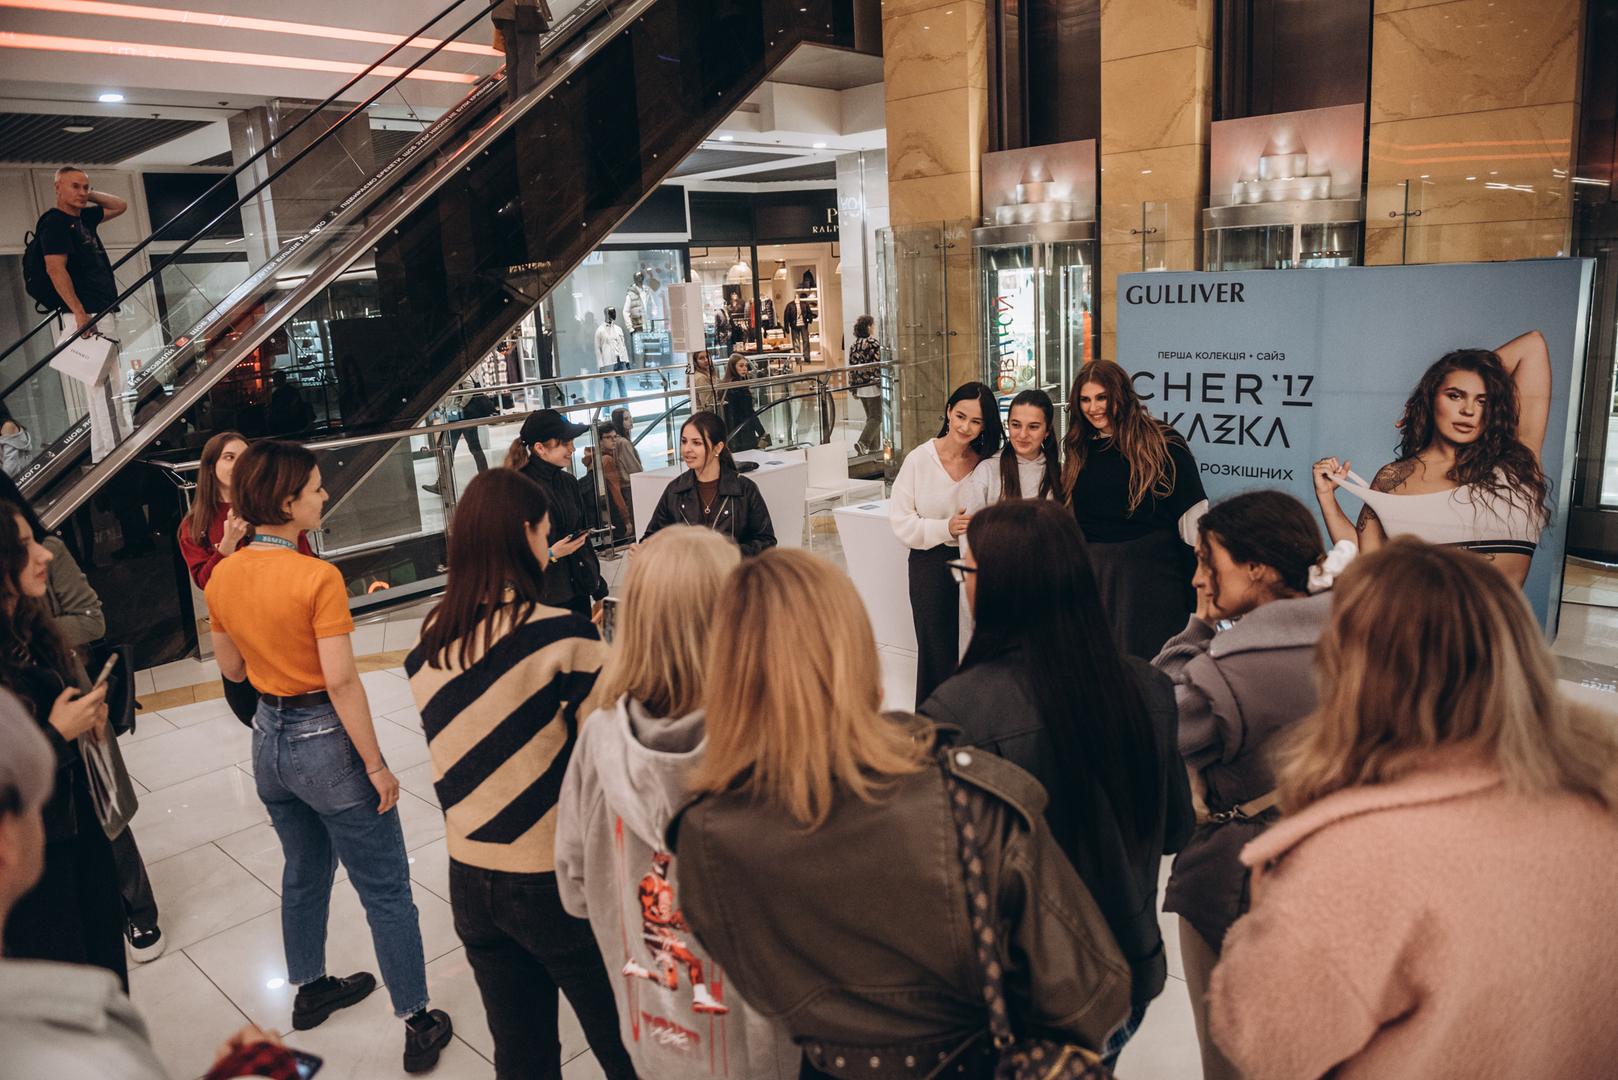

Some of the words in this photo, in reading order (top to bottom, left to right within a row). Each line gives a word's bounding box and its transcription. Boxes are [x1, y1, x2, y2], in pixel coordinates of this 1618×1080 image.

[402, 144, 417, 158] ЩОБ
[430, 118, 450, 135] НІКОЛИ
[812, 225, 839, 234] RALP
[1126, 282, 1245, 305] GULLIVER
[189, 321, 208, 336] ЩОБ
[992, 294, 1017, 430] ПОВНЮЙ
[1157, 351, 1193, 360] ПЕРША
[1195, 351, 1246, 361] КОЛЕКЦІЯ
[1256, 350, 1286, 361] сайз
[63, 427, 83, 445] ЩОБ
[141, 348, 176, 377] КРОВИЛИ
[15, 462, 42, 488] ЬКОГО
[1200, 463, 1294, 481] РОЗКІШНИХ
